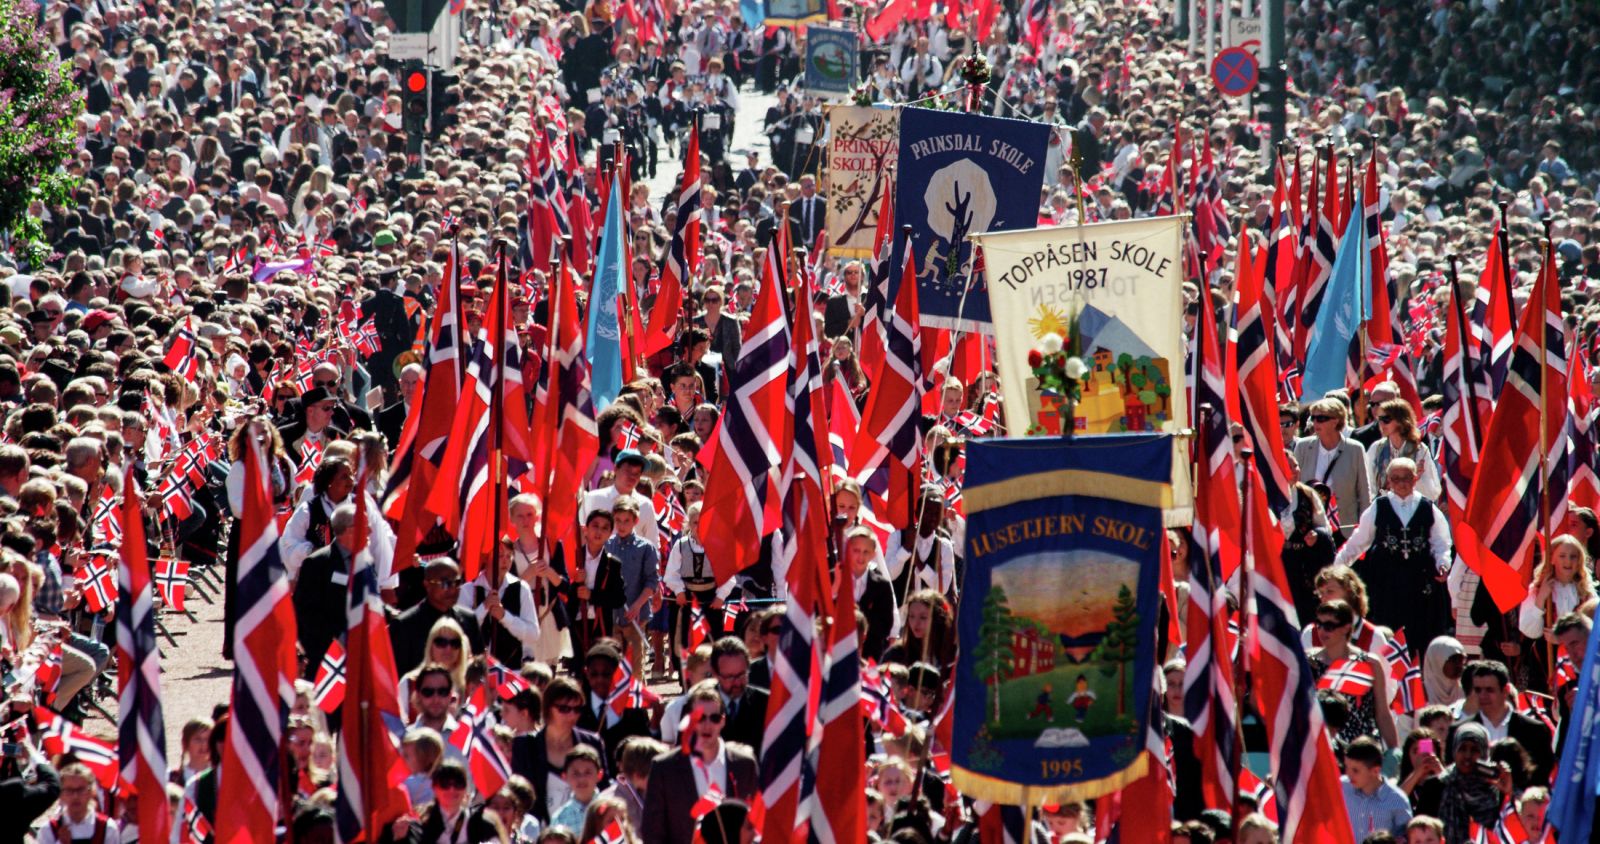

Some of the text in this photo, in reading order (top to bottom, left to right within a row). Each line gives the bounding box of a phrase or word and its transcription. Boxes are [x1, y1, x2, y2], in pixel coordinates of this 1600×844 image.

[910, 134, 1034, 174] PRINSDAL SKOLE
[998, 240, 1172, 290] TOPPÅSEN SKOLE
[1067, 268, 1108, 290] 1987
[971, 514, 1155, 557] LUSETJERN SKOL
[1041, 759, 1083, 779] 1995
